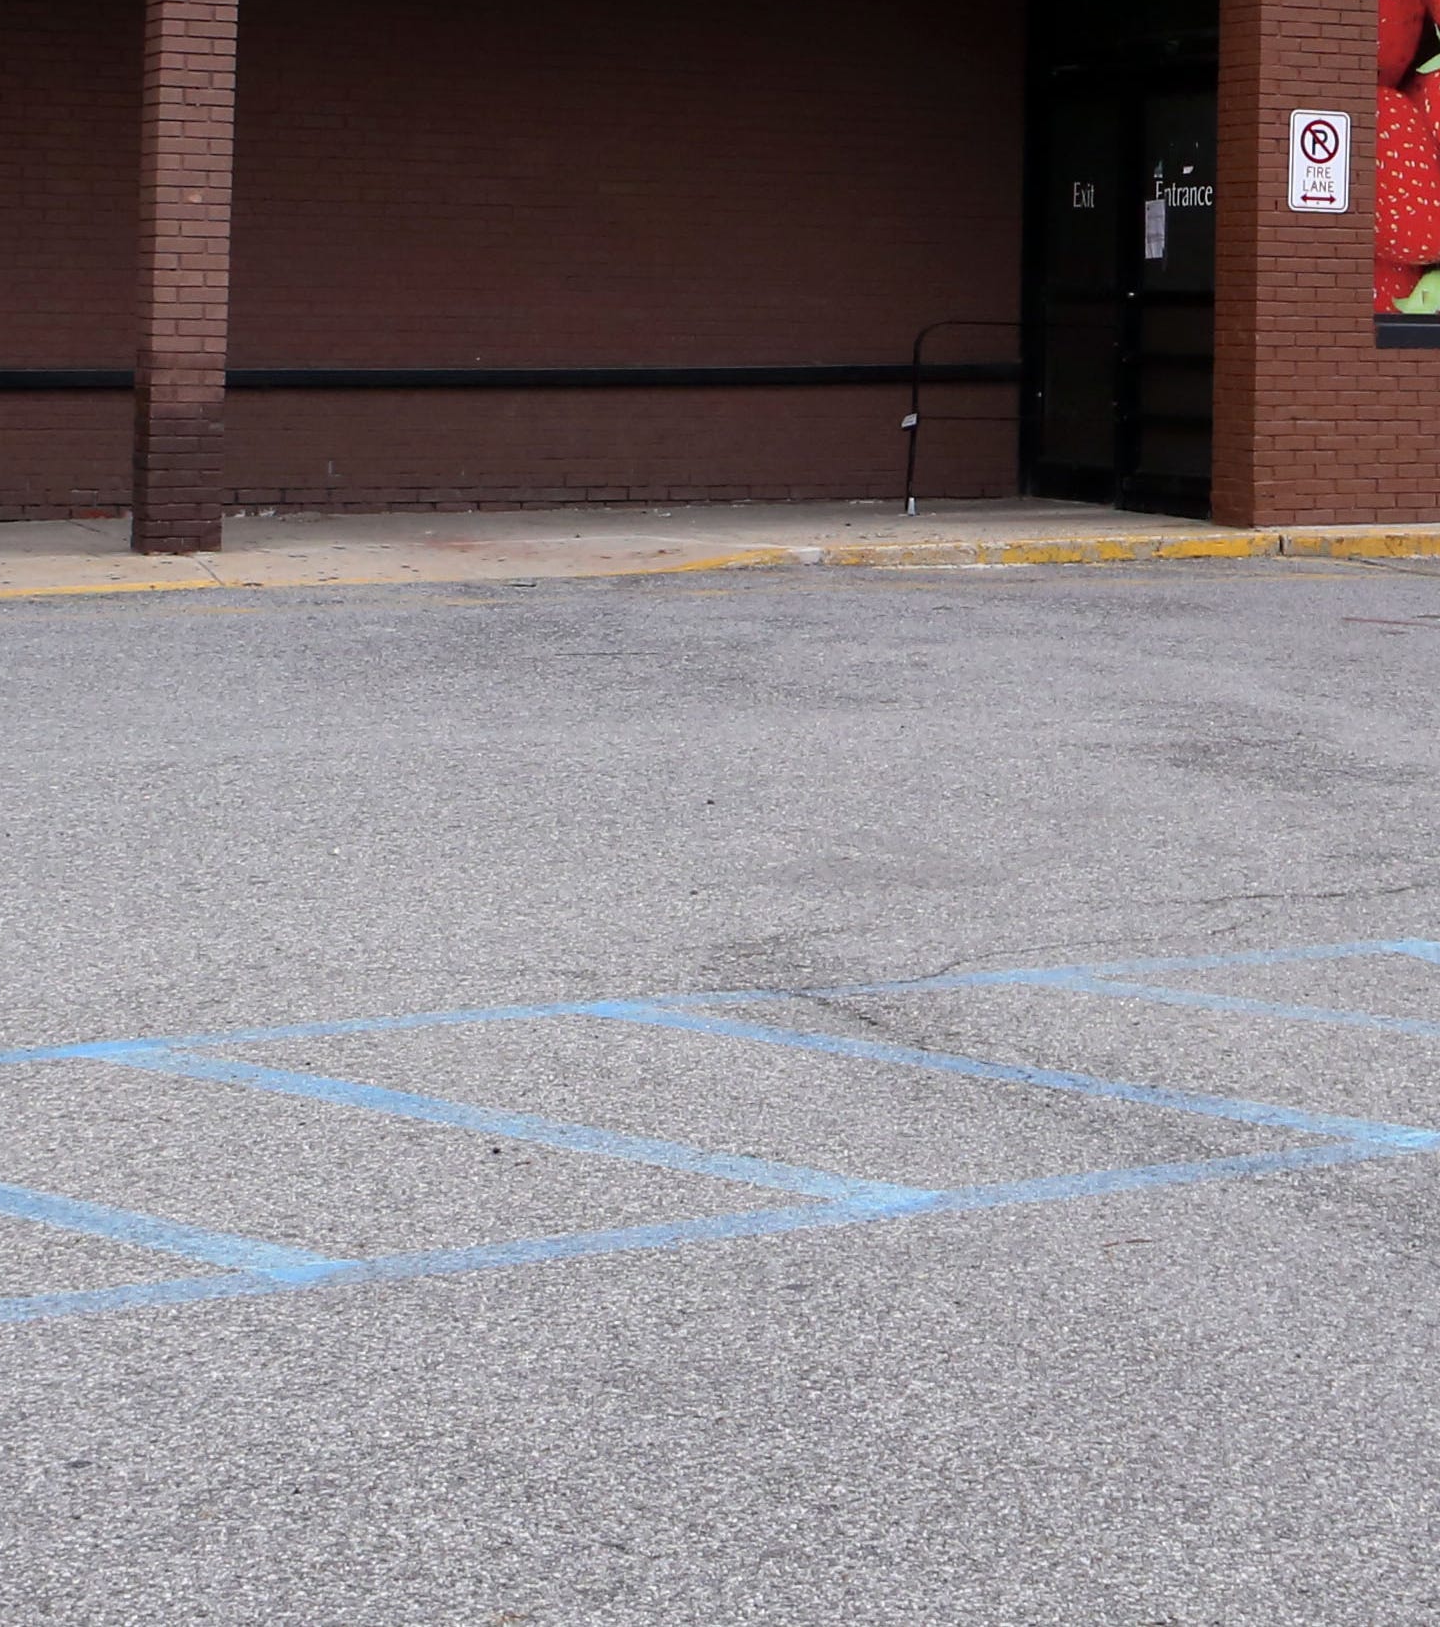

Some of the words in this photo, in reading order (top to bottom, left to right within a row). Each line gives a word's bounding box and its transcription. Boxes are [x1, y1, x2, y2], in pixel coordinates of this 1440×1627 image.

[1306, 166, 1331, 179] FIRE
[1072, 181, 1095, 208] Exit
[1156, 180, 1213, 207] Entrance
[1302, 179, 1335, 193] LANE
